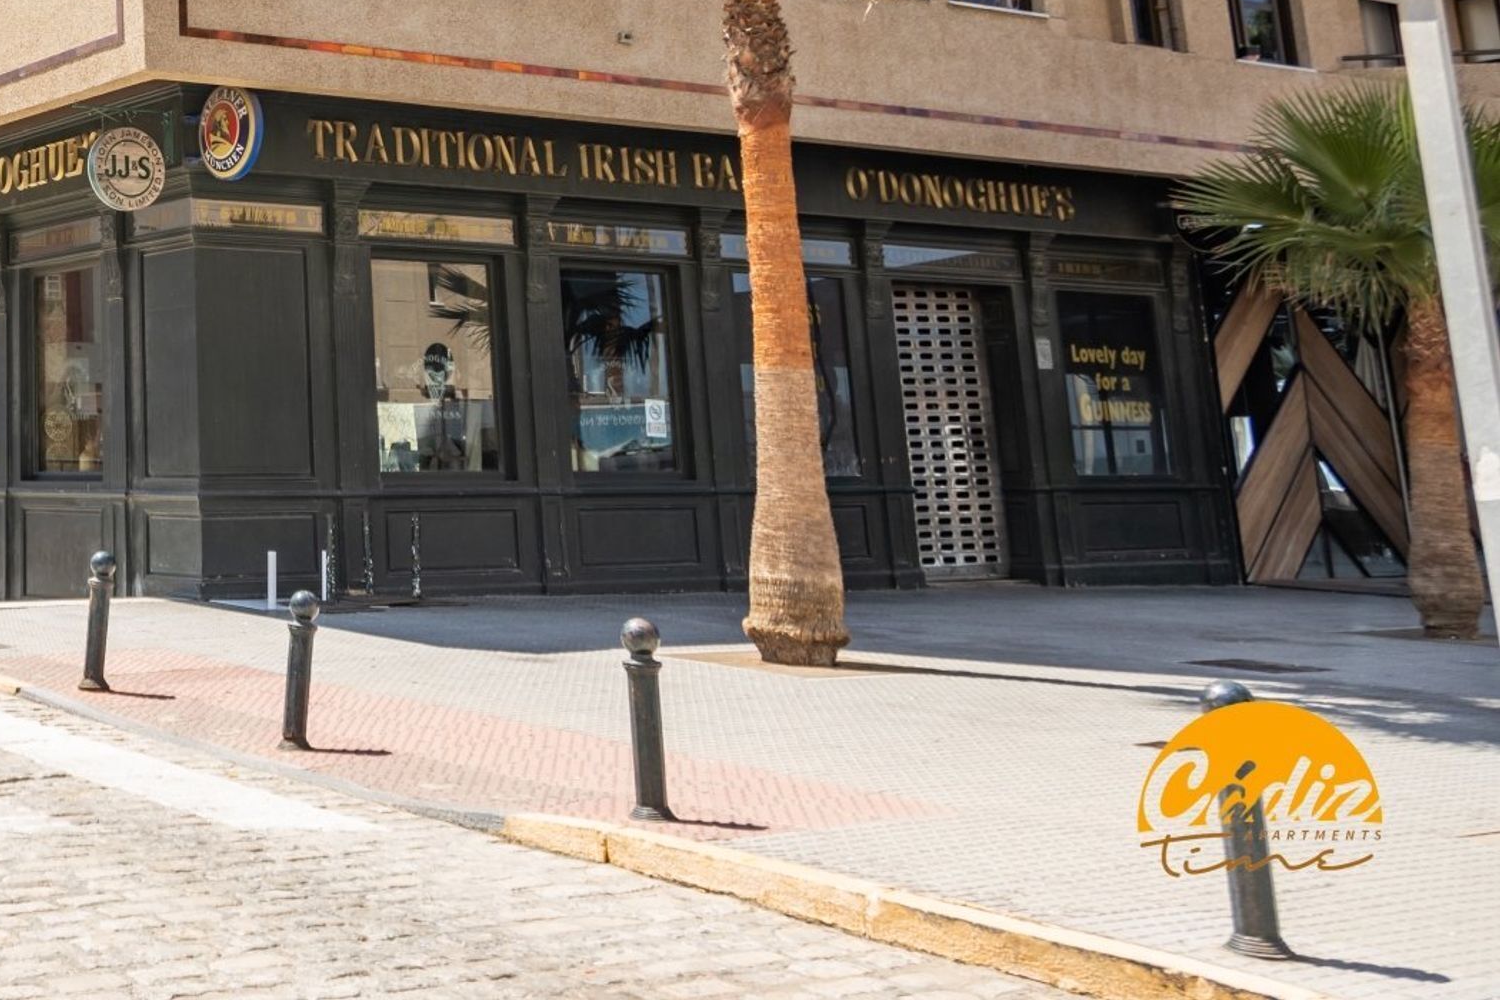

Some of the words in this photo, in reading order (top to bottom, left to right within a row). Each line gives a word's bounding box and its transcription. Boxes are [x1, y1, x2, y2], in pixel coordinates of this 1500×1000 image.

[104, 154, 150, 180] JJ&S
[307, 118, 568, 178] TRADITIONAL
[577, 143, 678, 188] IRISH
[690, 152, 744, 192] BA
[845, 166, 1077, 222] O'DONOGHUE'S
[1070, 343, 1116, 370] Lovely
[1121, 346, 1146, 371] day
[1095, 372, 1117, 391] for
[1121, 376, 1131, 391] a
[1079, 392, 1153, 425] GUINNESS
